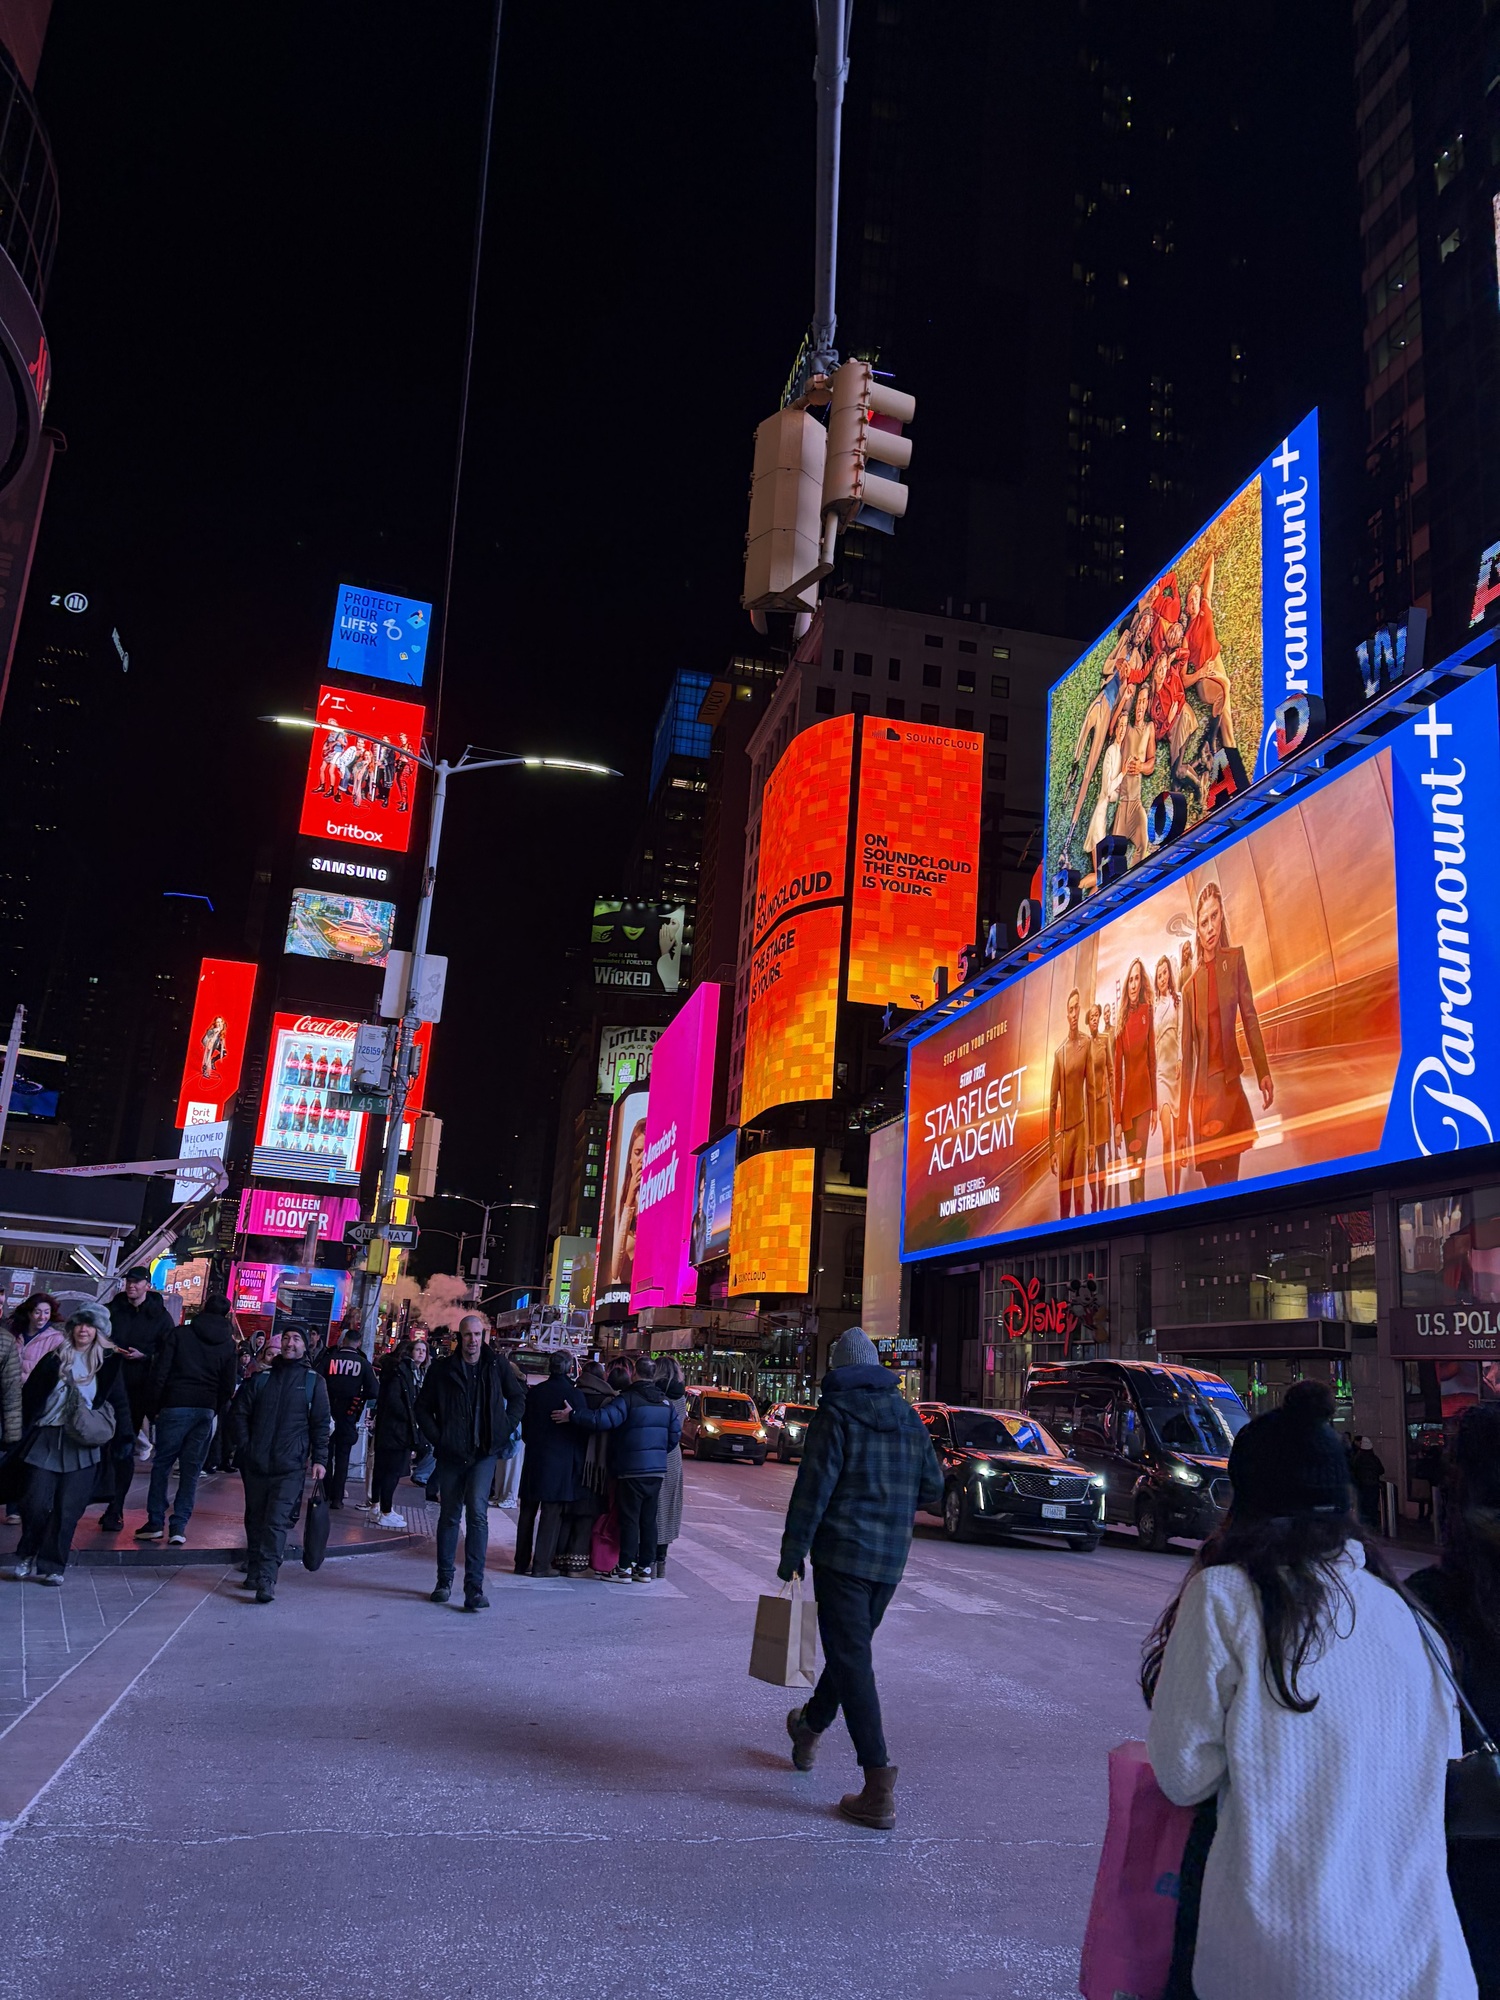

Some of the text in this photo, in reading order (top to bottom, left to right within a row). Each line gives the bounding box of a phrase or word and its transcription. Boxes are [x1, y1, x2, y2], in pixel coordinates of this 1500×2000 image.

[343, 604, 378, 621] YOUR
[344, 591, 402, 614] PROTECT
[340, 616, 378, 634] LIFE'S
[340, 629, 378, 647] WORK
[906, 732, 979, 751] SOUNDCLOUD
[326, 820, 384, 843] britbox
[864, 833, 888, 848] ON
[311, 856, 388, 882] SAMSUNG
[863, 847, 972, 874] SOUNDCLOUD
[861, 875, 877, 889] IS
[863, 860, 948, 884] THE STAGE
[755, 870, 833, 936] SOUNDCLOUD
[757, 884, 768, 910] ON
[752, 928, 796, 981] THE STAGE
[294, 1015, 358, 1042] Coca-Cola
[609, 1028, 648, 1050] LITTLE
[943, 1019, 1008, 1067] STEP INTO YOUR FUTURE
[959, 1062, 987, 1089] STAR TREK
[192, 1107, 210, 1117] brit
[343, 1094, 353, 1108] W
[358, 1097, 373, 1111] 45
[924, 1065, 1028, 1142] STARFLEET
[184, 1132, 223, 1144] WELCOME TO
[928, 1109, 1019, 1175] ACADEMY
[954, 1176, 986, 1197] NEW SERIES
[277, 1196, 321, 1211] COLLEEN
[939, 1186, 1000, 1218] NOW STREAMING
[240, 1278, 262, 1288] DOWN
[1415, 1310, 1500, 1336] U.S. POL
[878, 1339, 892, 1352] GIFTS
[1468, 1338, 1497, 1349] SINCE
[329, 1359, 361, 1377] NYPD
